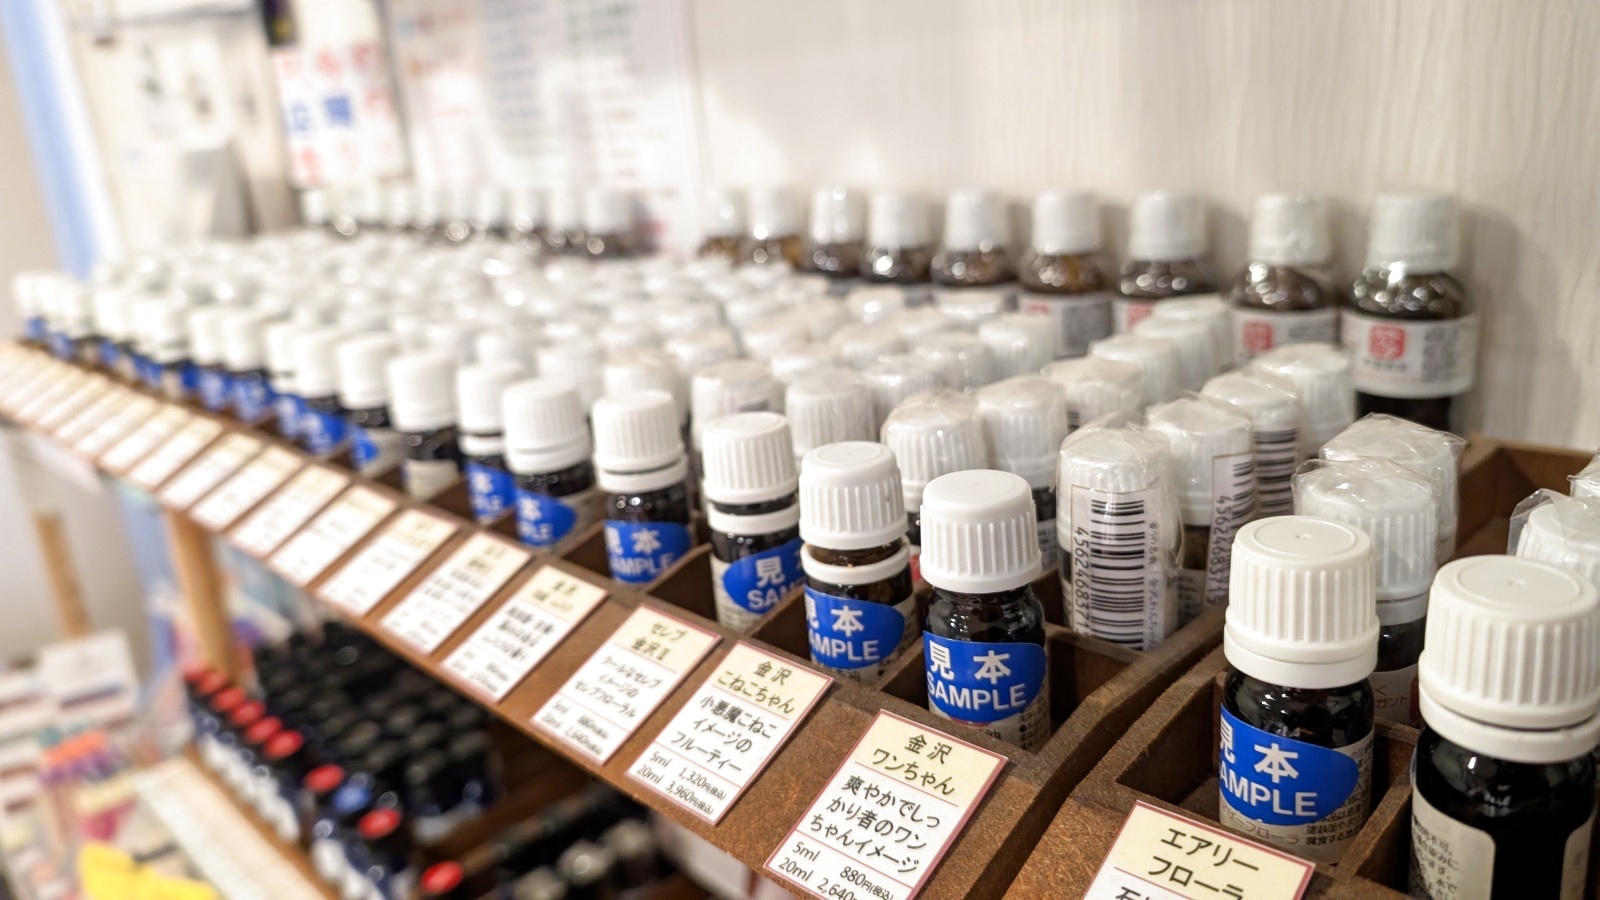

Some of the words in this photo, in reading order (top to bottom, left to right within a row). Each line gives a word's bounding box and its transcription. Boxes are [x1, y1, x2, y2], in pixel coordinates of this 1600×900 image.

[755, 551, 800, 587] 見
[754, 661, 792, 685] 金沢
[929, 640, 1011, 684] 見本
[717, 670, 795, 714] こねこちゃん
[927, 671, 1026, 711] SAMPLE
[693, 718, 752, 752] イメージの
[699, 696, 778, 739] 小悪魔こねこ
[671, 731, 742, 772] フルーティー
[904, 734, 953, 765] 金沢
[872, 748, 955, 796] ワンちゃん
[841, 774, 941, 829] 爽やかでしっ
[810, 814, 920, 873] ちゃんイメージ
[825, 796, 927, 850] かり者のワン
[778, 857, 814, 882] 20ml
[792, 841, 821, 863] 5ml
[1160, 828, 1259, 871] エアリー
